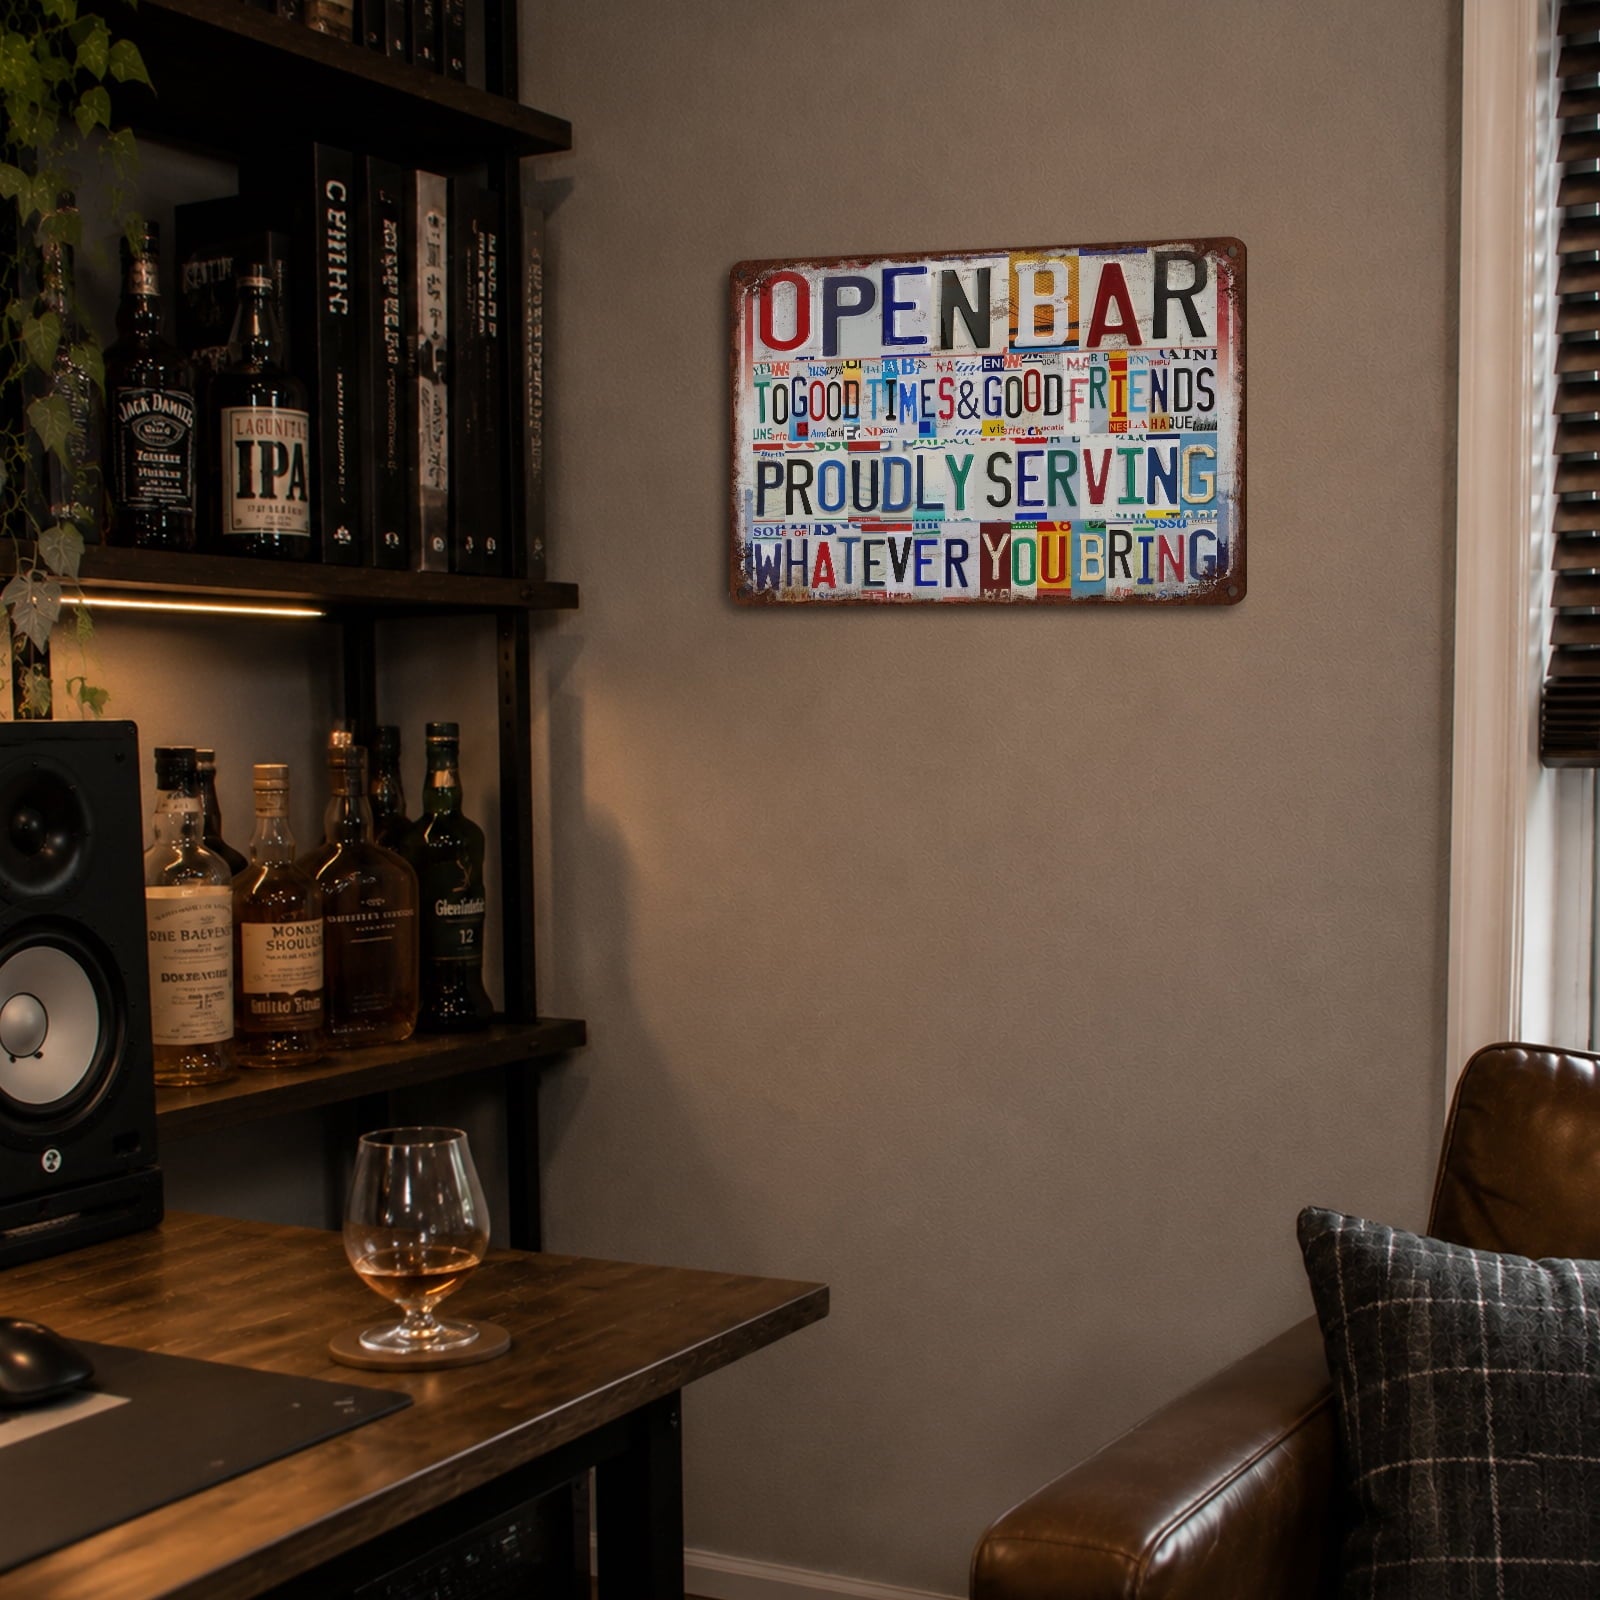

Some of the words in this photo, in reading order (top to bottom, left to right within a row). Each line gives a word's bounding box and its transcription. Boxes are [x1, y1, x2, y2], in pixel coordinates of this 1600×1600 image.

[759, 266, 990, 357] OPEN
[1014, 250, 1208, 348] BAR
[754, 381, 789, 425] TO
[791, 376, 860, 421] GOOD
[866, 376, 955, 425] TIMES
[957, 380, 981, 420] &
[984, 368, 1063, 419] GOOD
[1069, 366, 1215, 423] FRIENDS
[235, 440, 308, 502] IPA
[756, 453, 974, 517] PROUDLY
[986, 444, 1216, 507] SERVING
[754, 537, 969, 590] WHATEVER
[982, 533, 1066, 587] YOU
[1079, 529, 1217, 585] BRING
[459, 928, 475, 945] 12
